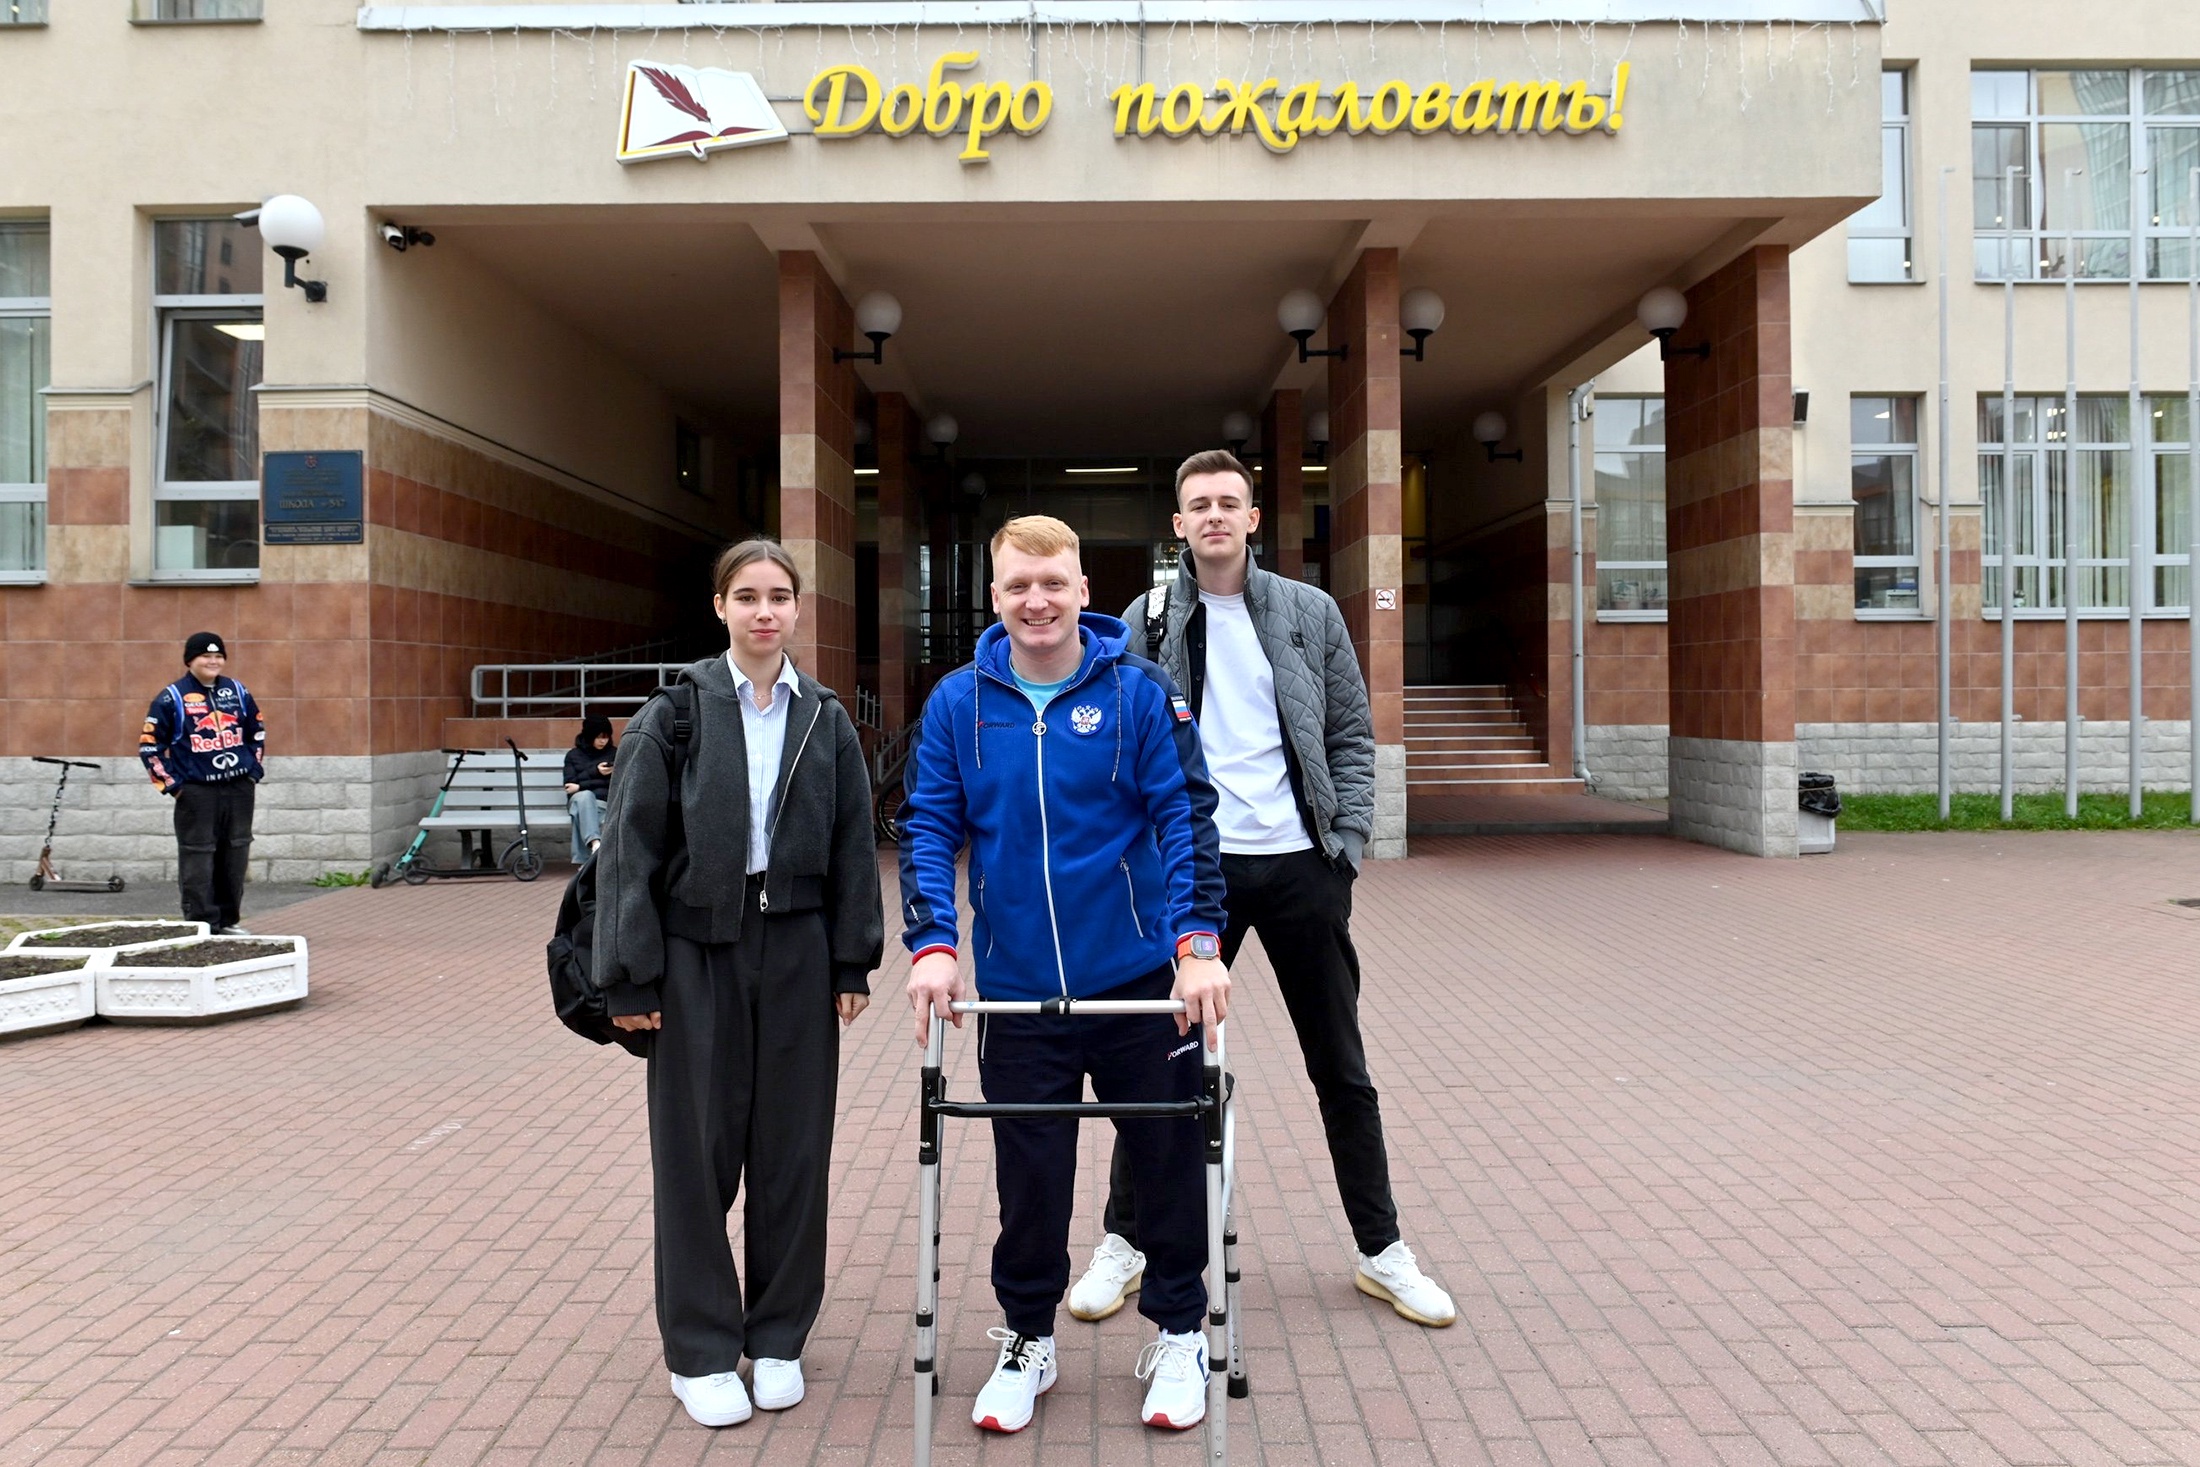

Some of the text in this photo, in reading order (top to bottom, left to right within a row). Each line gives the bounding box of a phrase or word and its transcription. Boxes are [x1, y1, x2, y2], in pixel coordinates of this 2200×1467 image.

[803, 50, 1631, 163] Добро пожаловать!
[190, 733, 224, 753] Red
